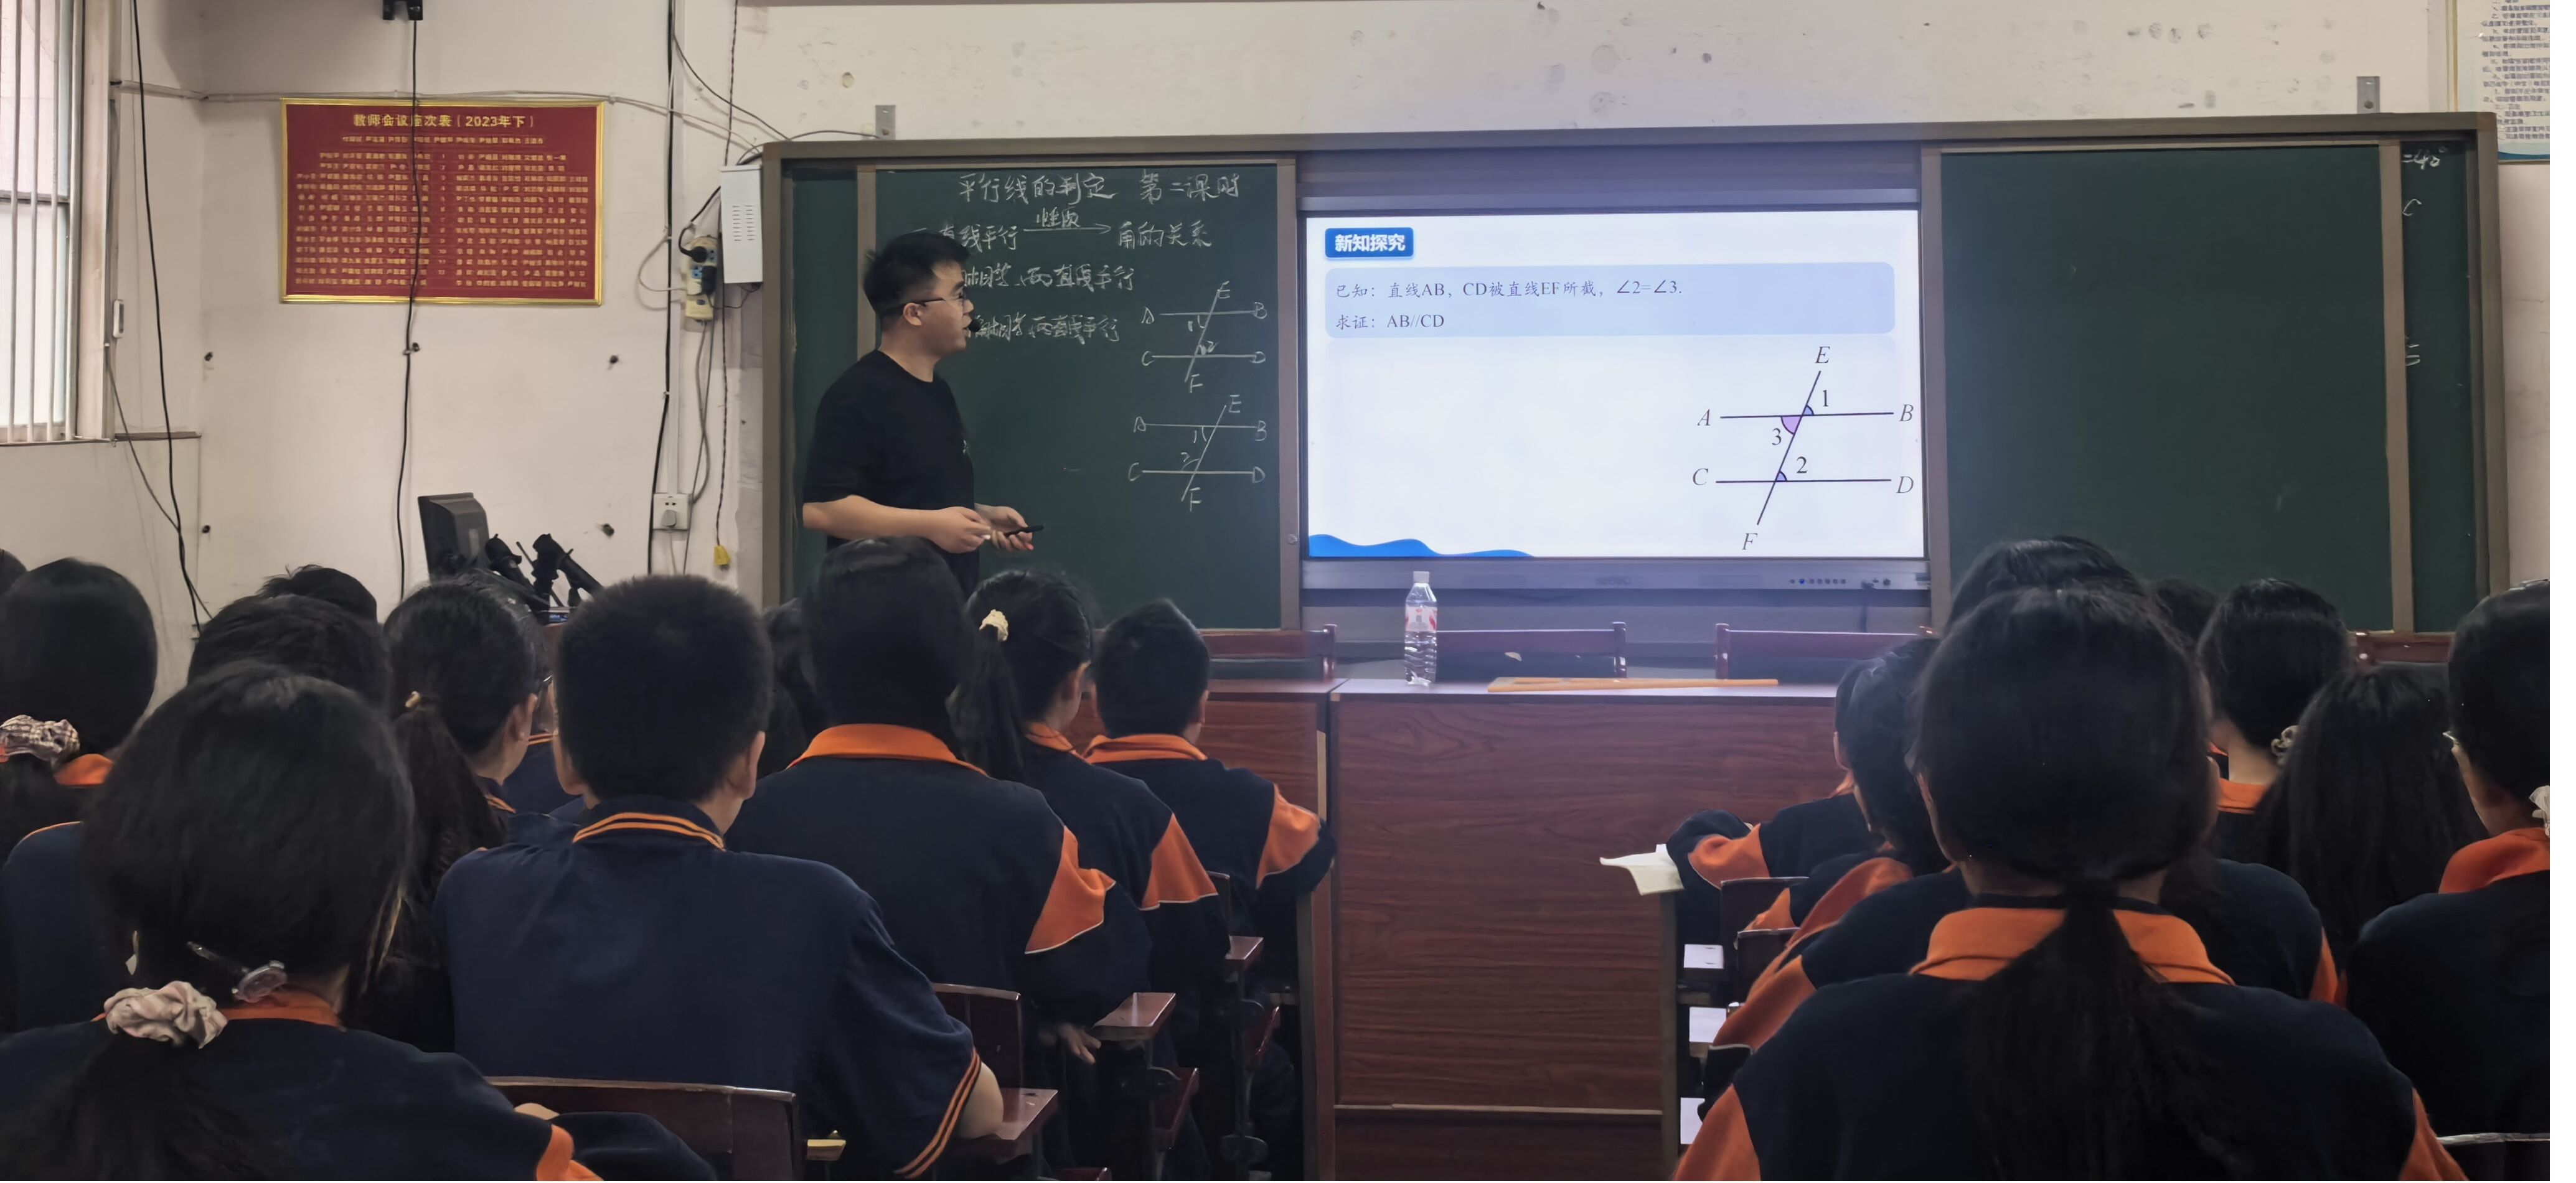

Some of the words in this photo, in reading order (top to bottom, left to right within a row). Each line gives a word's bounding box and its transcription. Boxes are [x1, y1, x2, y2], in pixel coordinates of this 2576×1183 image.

[959, 172, 1119, 205] 平行线的判定
[1140, 168, 1240, 205] 第二课时
[1117, 219, 1213, 250] 角的关系
[1334, 233, 1406, 252] 新知探究
[1815, 345, 1831, 365] E
[1189, 373, 1203, 393] F
[1228, 393, 1243, 413] E
[1822, 389, 1830, 408] 1
[1697, 408, 1711, 427] A
[1899, 403, 1914, 422] B
[1770, 428, 1782, 446] 3
[1127, 461, 1143, 482] C
[1251, 465, 1266, 484] D
[1795, 456, 1808, 474] 2
[1692, 467, 1709, 486] C
[1896, 475, 1914, 494] D
[1189, 486, 1203, 512] F
[1741, 532, 1758, 551] F
